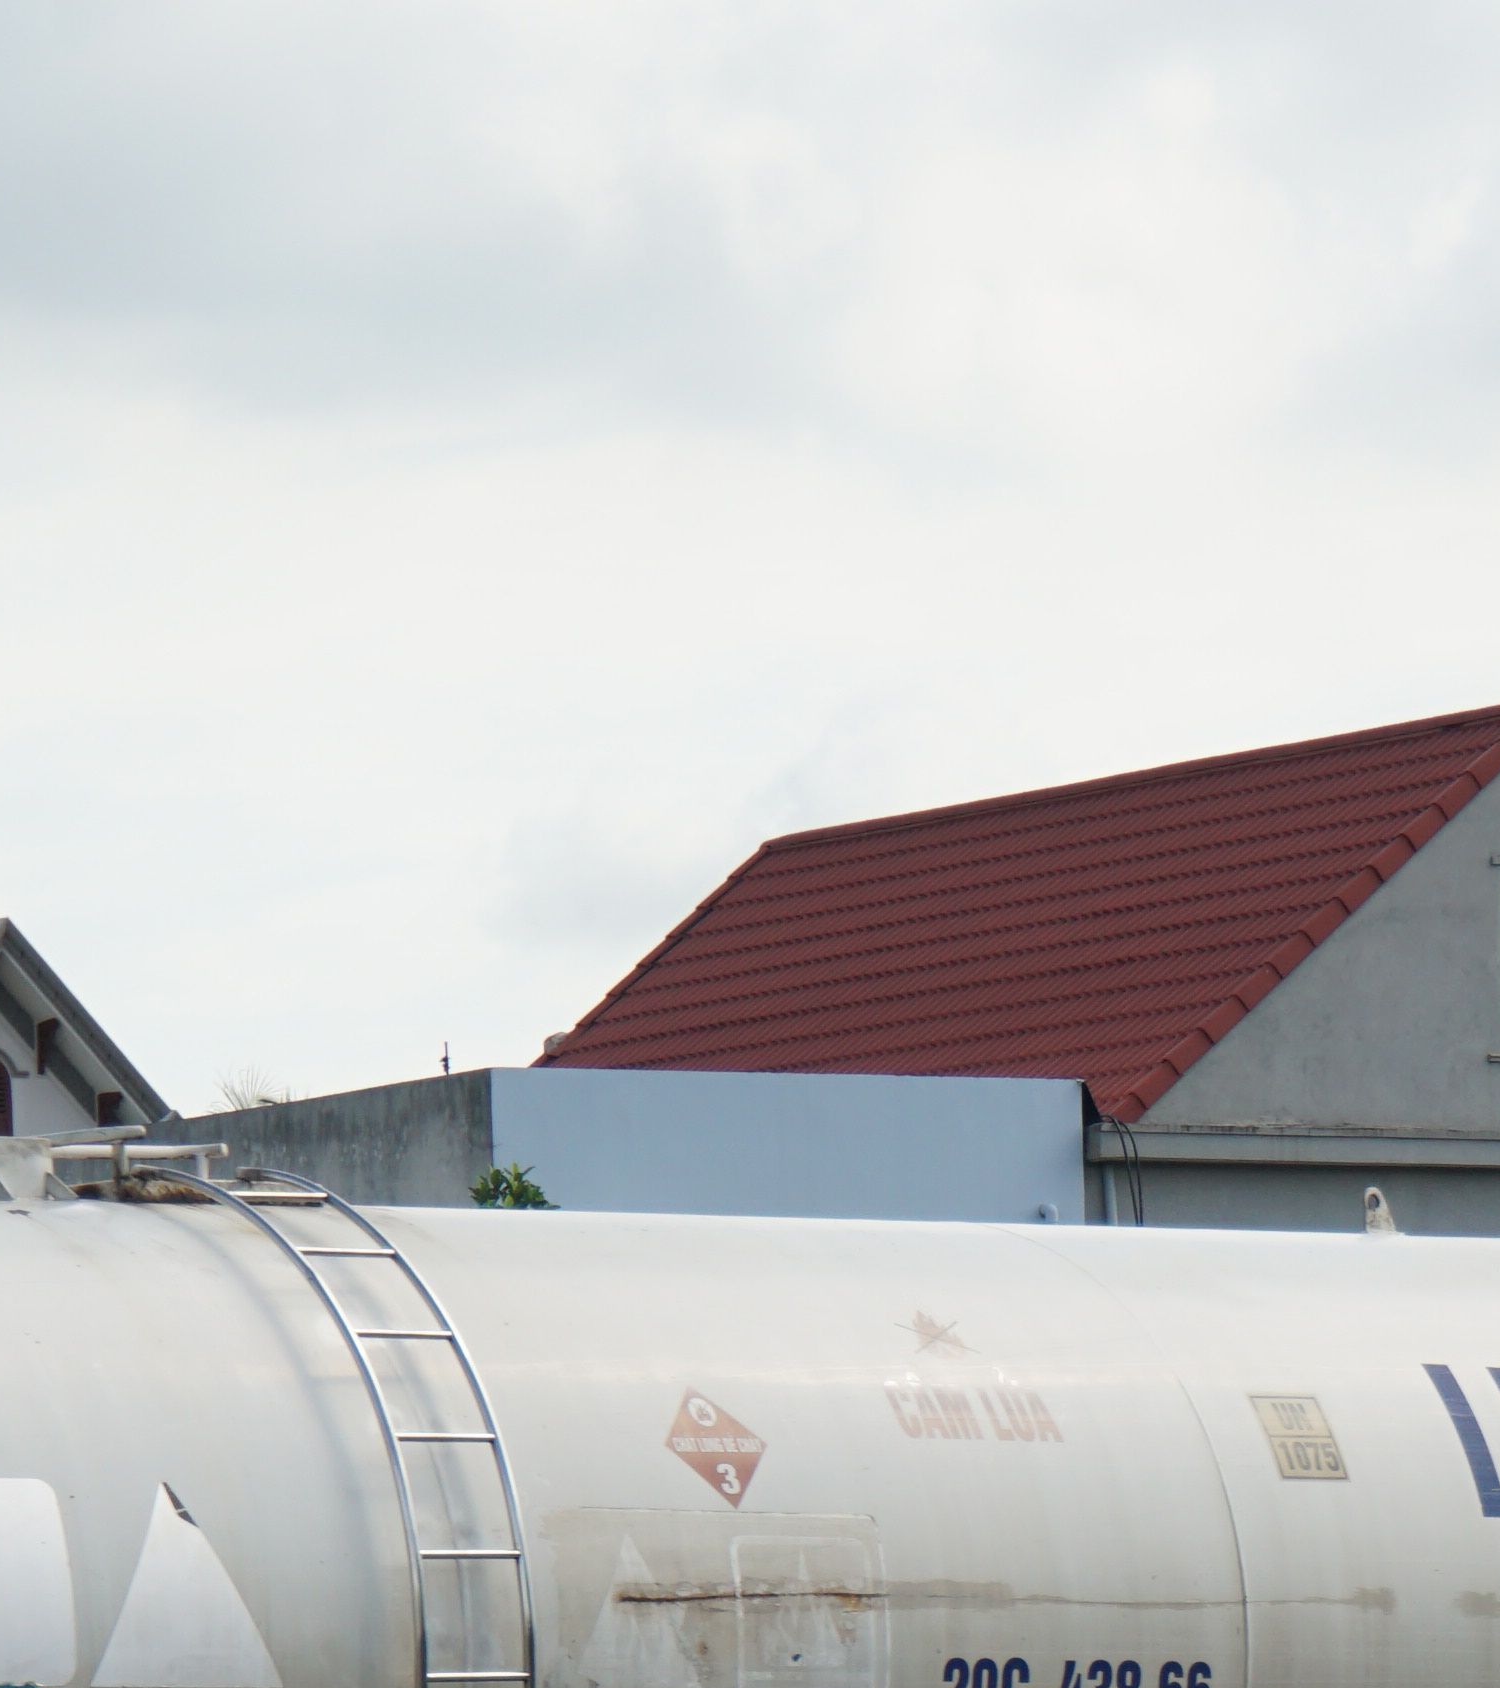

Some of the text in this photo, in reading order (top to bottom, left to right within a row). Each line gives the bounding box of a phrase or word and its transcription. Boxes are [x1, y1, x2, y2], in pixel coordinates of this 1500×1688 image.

[1270, 1401, 1314, 1431] UN
[1278, 1441, 1340, 1472] 1075
[716, 1463, 741, 1495] 3
